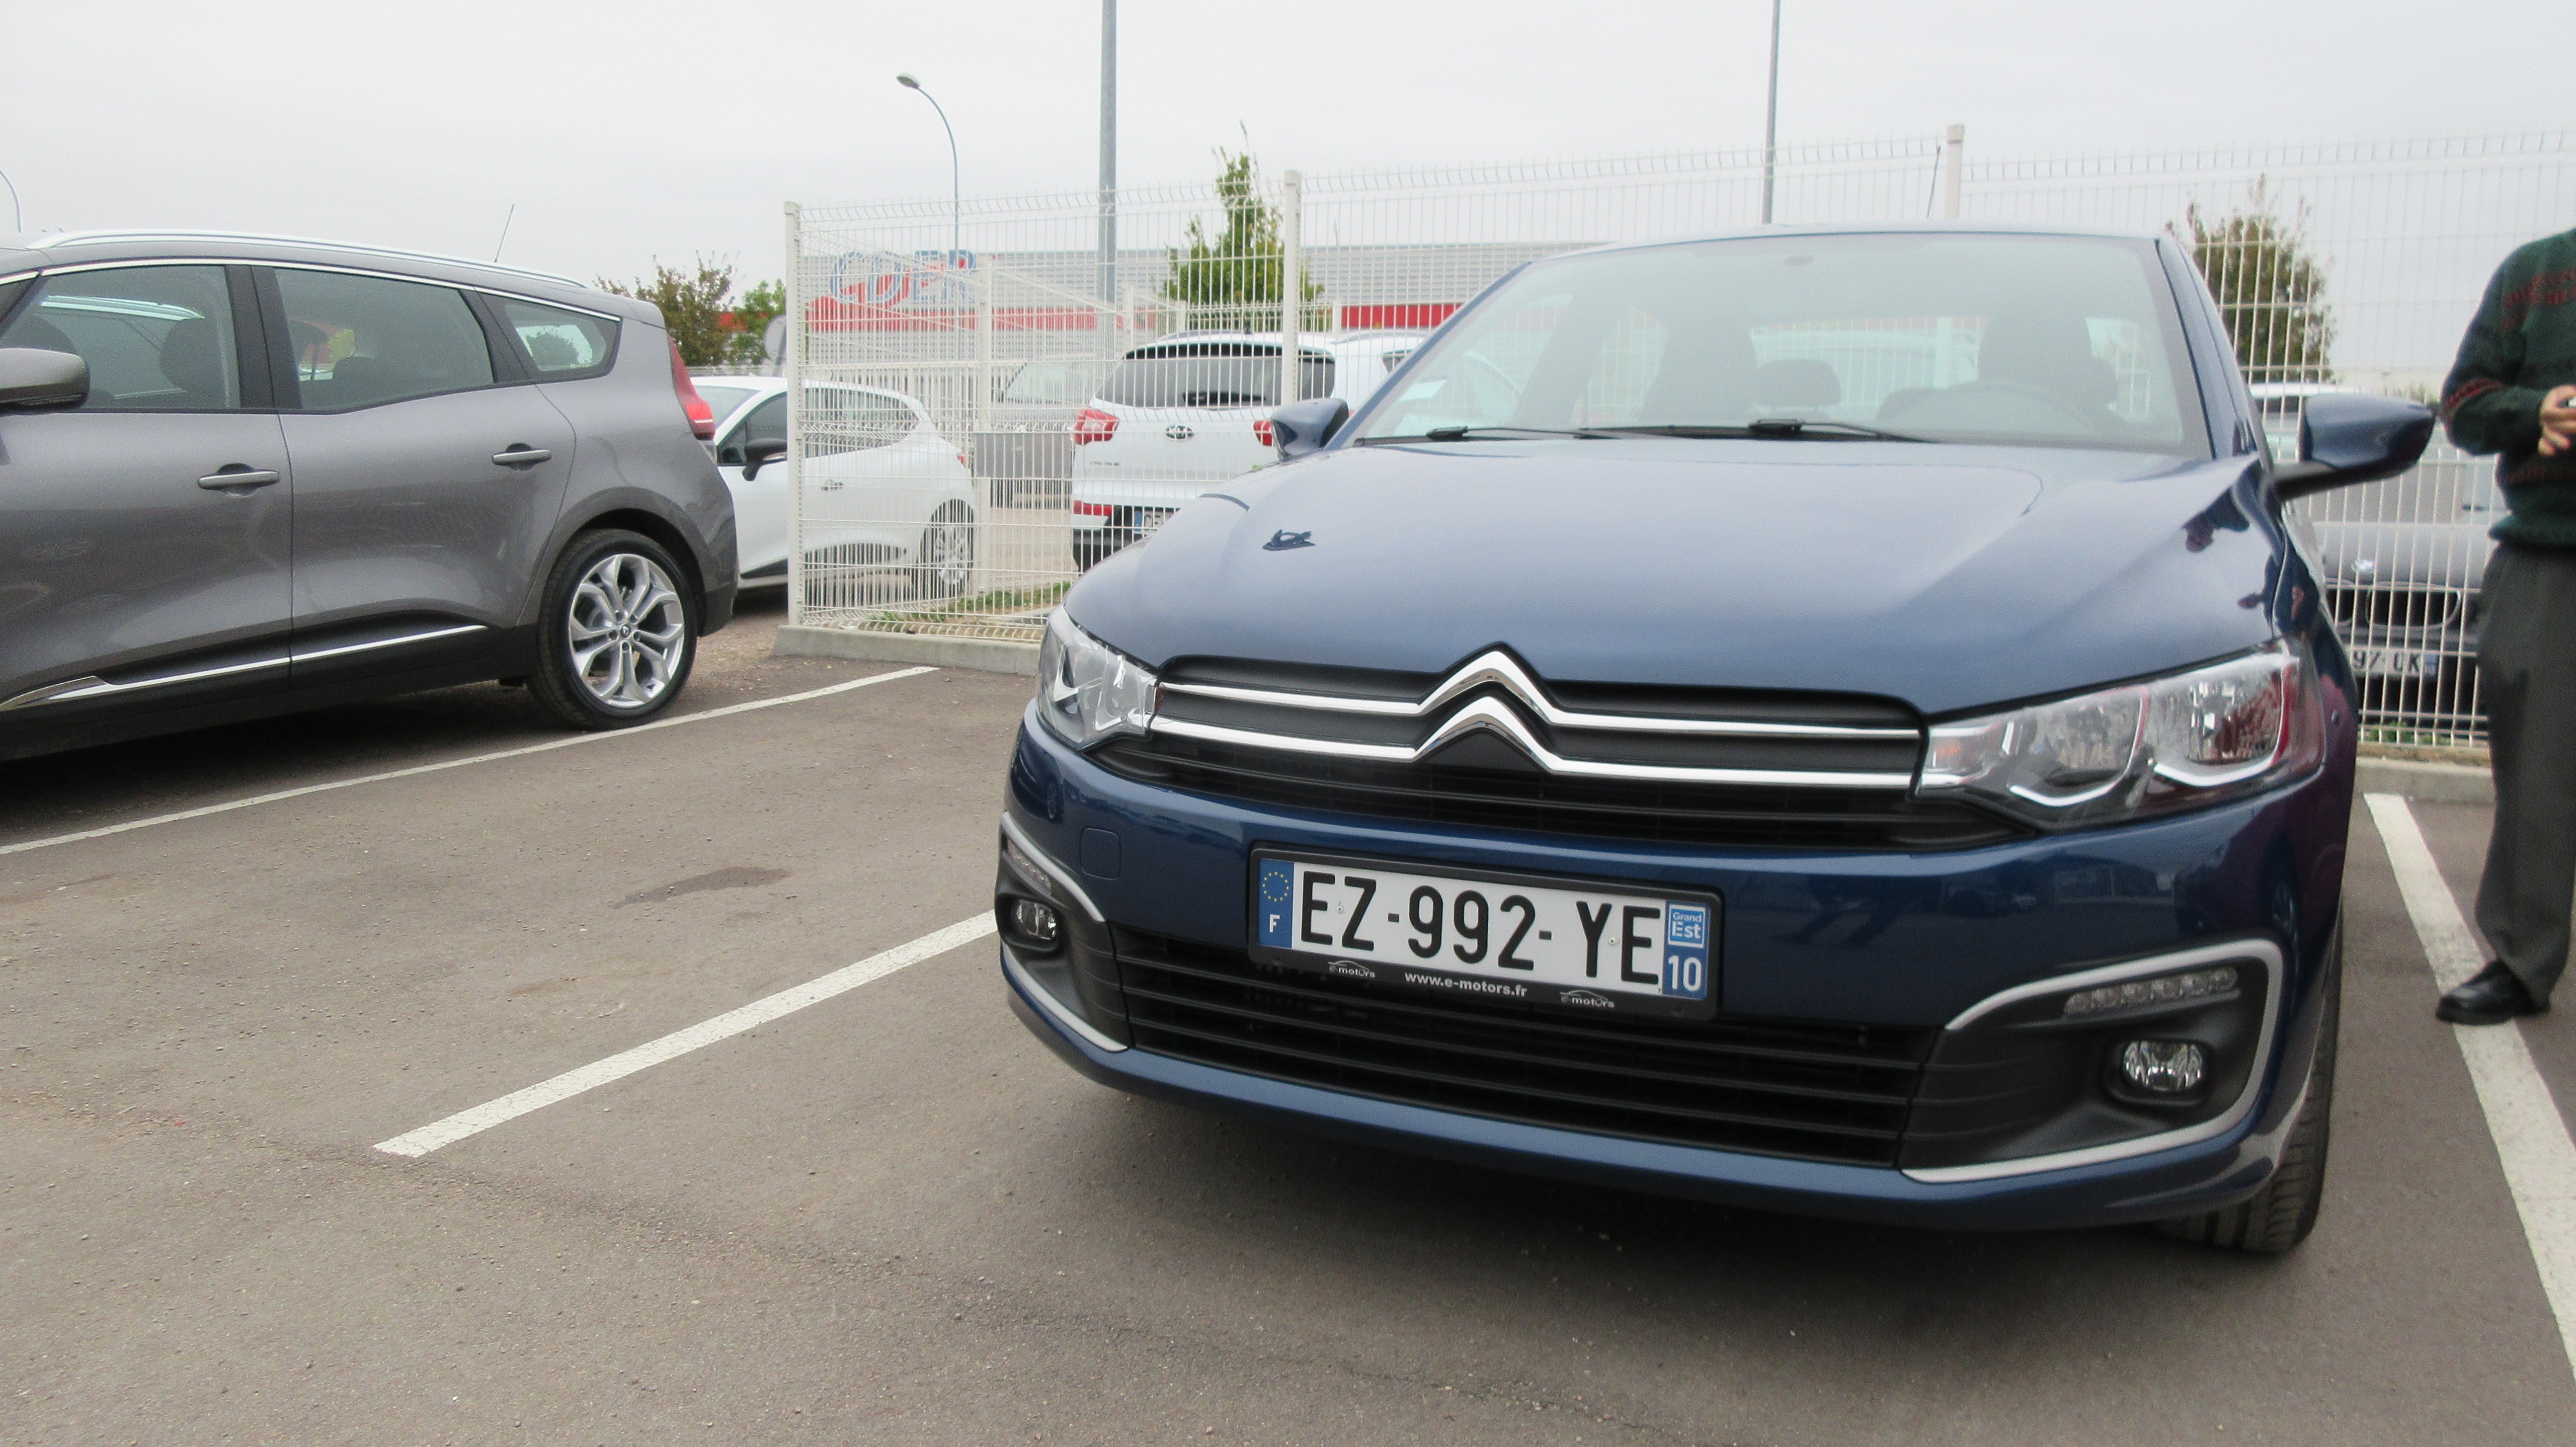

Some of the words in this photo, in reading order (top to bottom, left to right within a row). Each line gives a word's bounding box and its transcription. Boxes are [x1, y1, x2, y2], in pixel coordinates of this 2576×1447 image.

[1270, 914, 1281, 933] F
[1673, 912, 1702, 923] Grand
[1672, 921, 1701, 939] Est
[1668, 955, 1702, 991] 10
[1404, 972, 1528, 997] www.e-motors.fr
